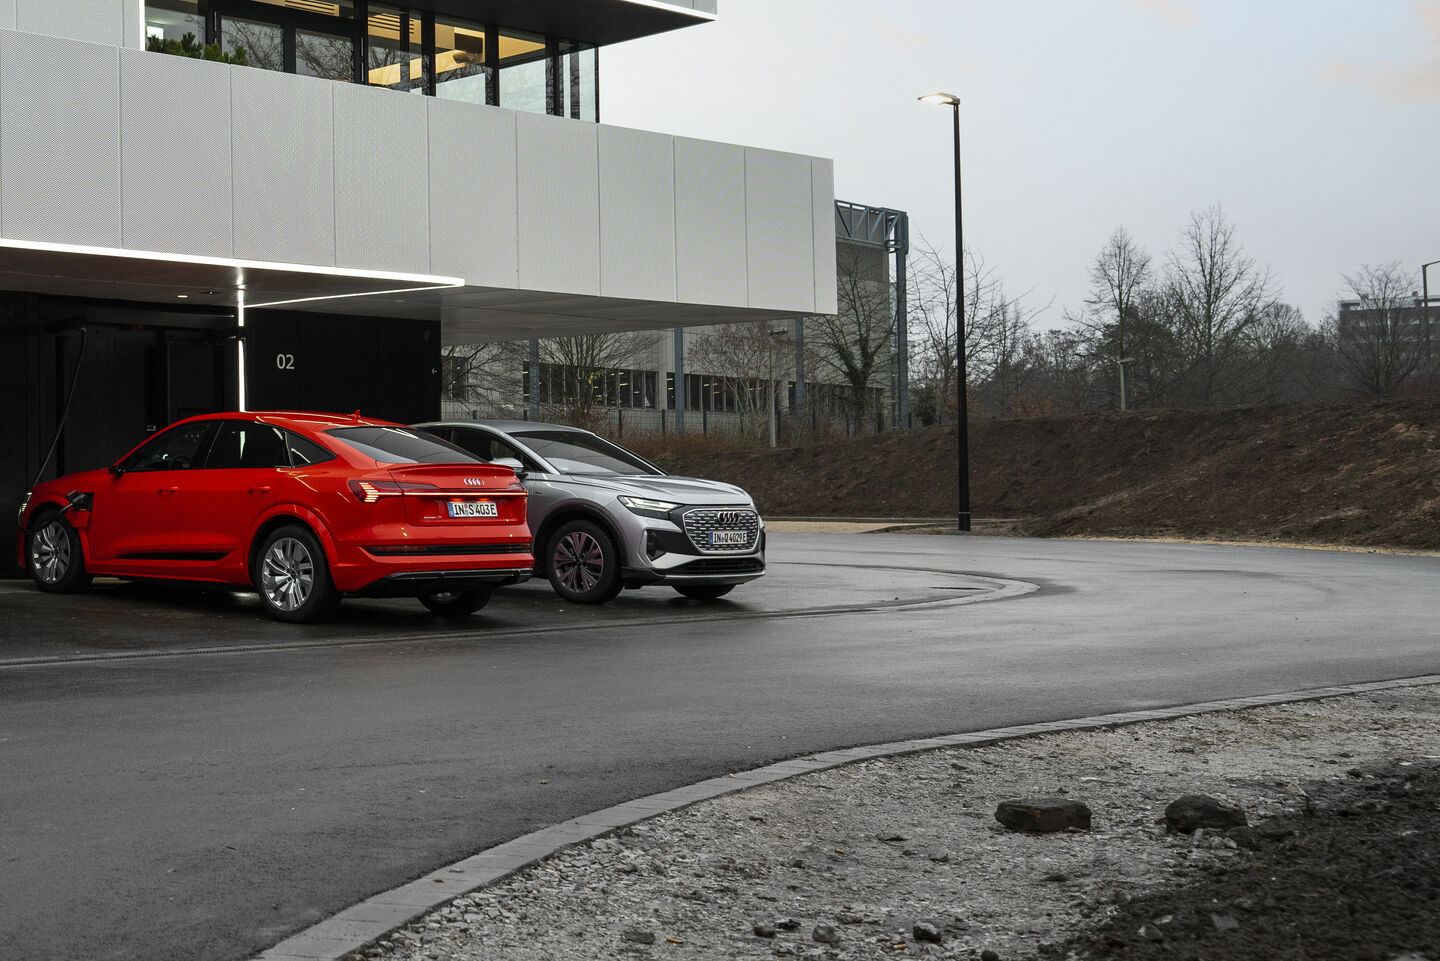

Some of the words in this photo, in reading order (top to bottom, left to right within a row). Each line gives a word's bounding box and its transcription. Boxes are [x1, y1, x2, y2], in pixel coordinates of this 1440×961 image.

[276, 354, 295, 370] 02
[454, 504, 465, 515] IN
[468, 504, 475, 515] S
[475, 504, 497, 515] 403E
